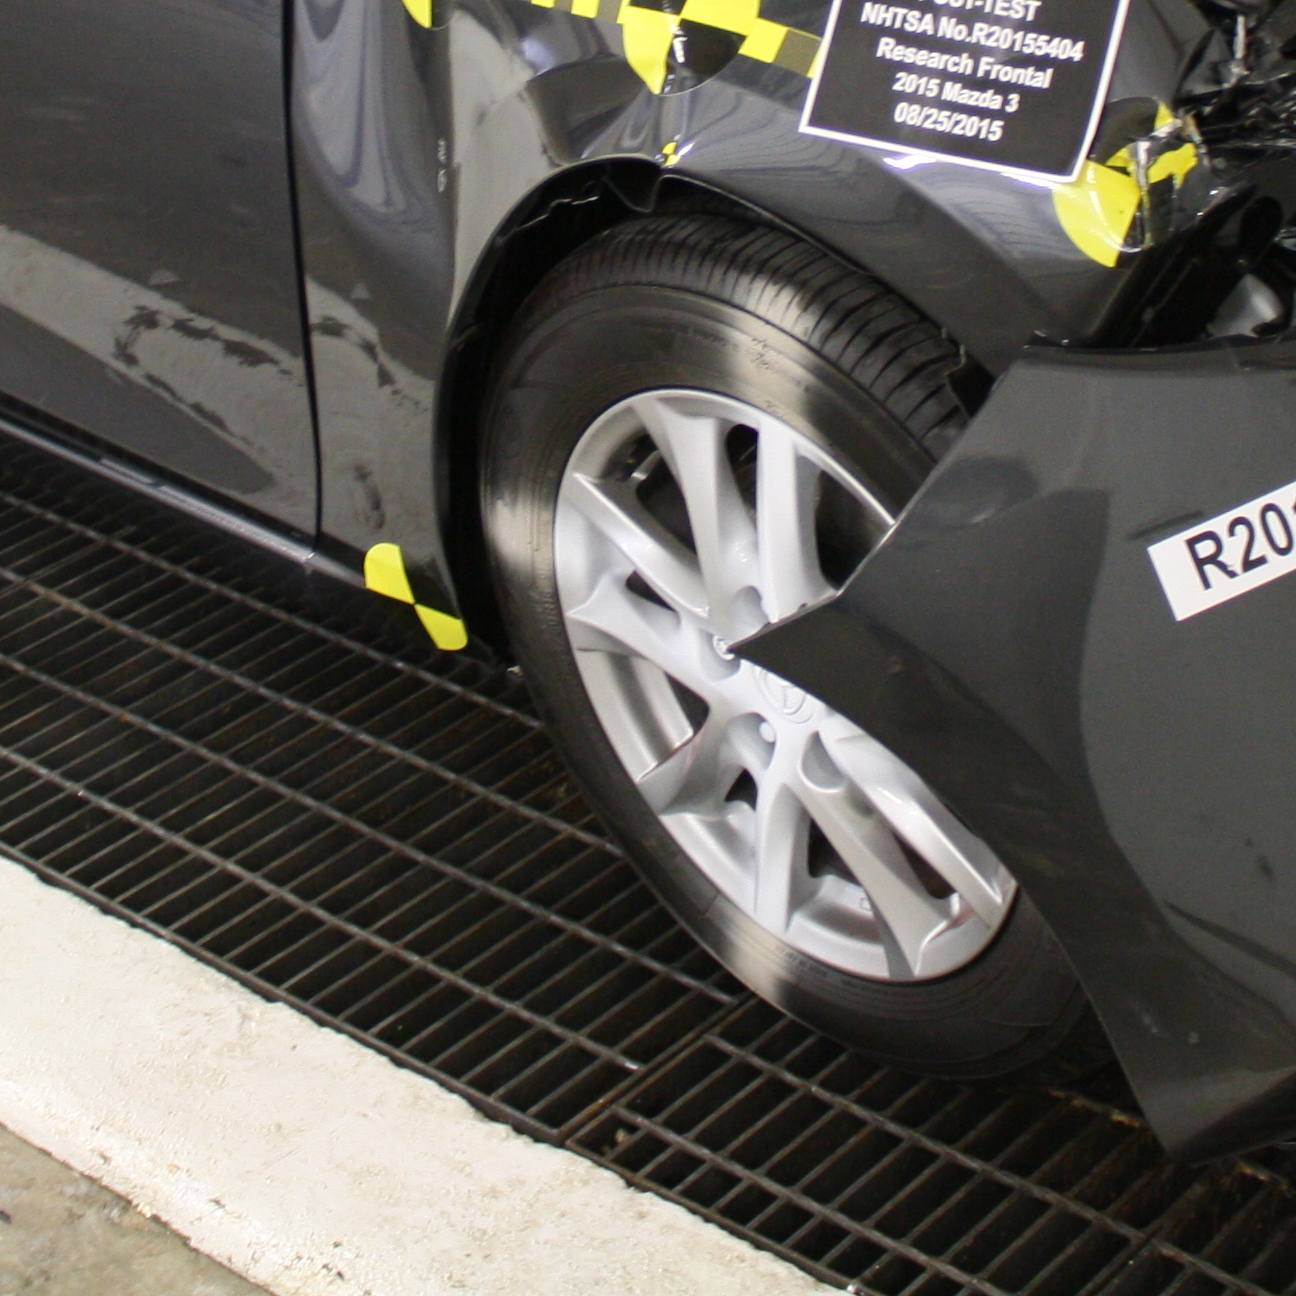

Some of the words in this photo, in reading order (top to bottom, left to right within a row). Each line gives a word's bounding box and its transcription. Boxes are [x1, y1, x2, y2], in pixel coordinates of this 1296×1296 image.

[860, 2, 934, 37] NHTSA
[876, 37, 974, 76] Research
[977, 56, 1054, 89] Frontal
[892, 72, 941, 99] 2015
[941, 81, 1002, 111] Mazda
[1005, 92, 1020, 114] 3
[893, 102, 1004, 142] 08/25/2015
